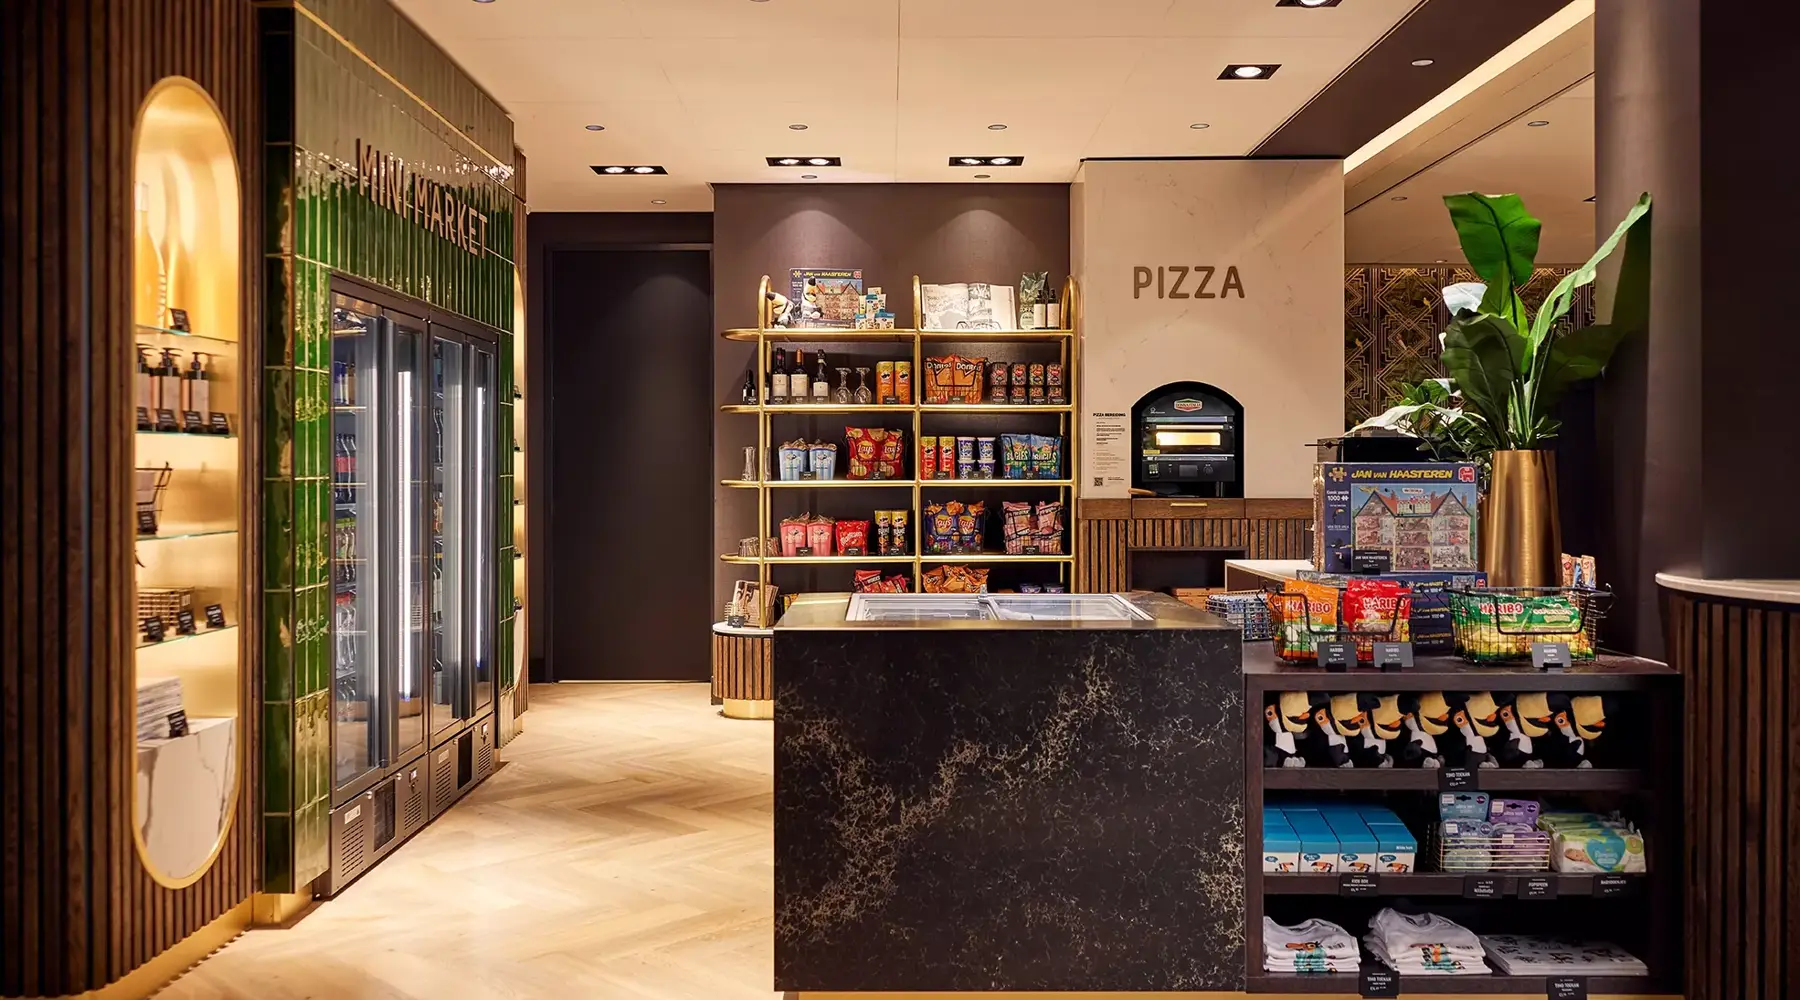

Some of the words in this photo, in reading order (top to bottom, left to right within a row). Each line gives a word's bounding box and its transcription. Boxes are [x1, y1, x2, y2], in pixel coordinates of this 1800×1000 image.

[356, 138, 407, 219] MINI
[411, 172, 488, 259] MARKET
[1133, 265, 1245, 299] PIZZA
[1351, 470, 1372, 479] JAN
[1389, 469, 1453, 479] HAASTEREN
[1363, 597, 1408, 610] HARIBO
[1480, 602, 1524, 614] HARIBO
